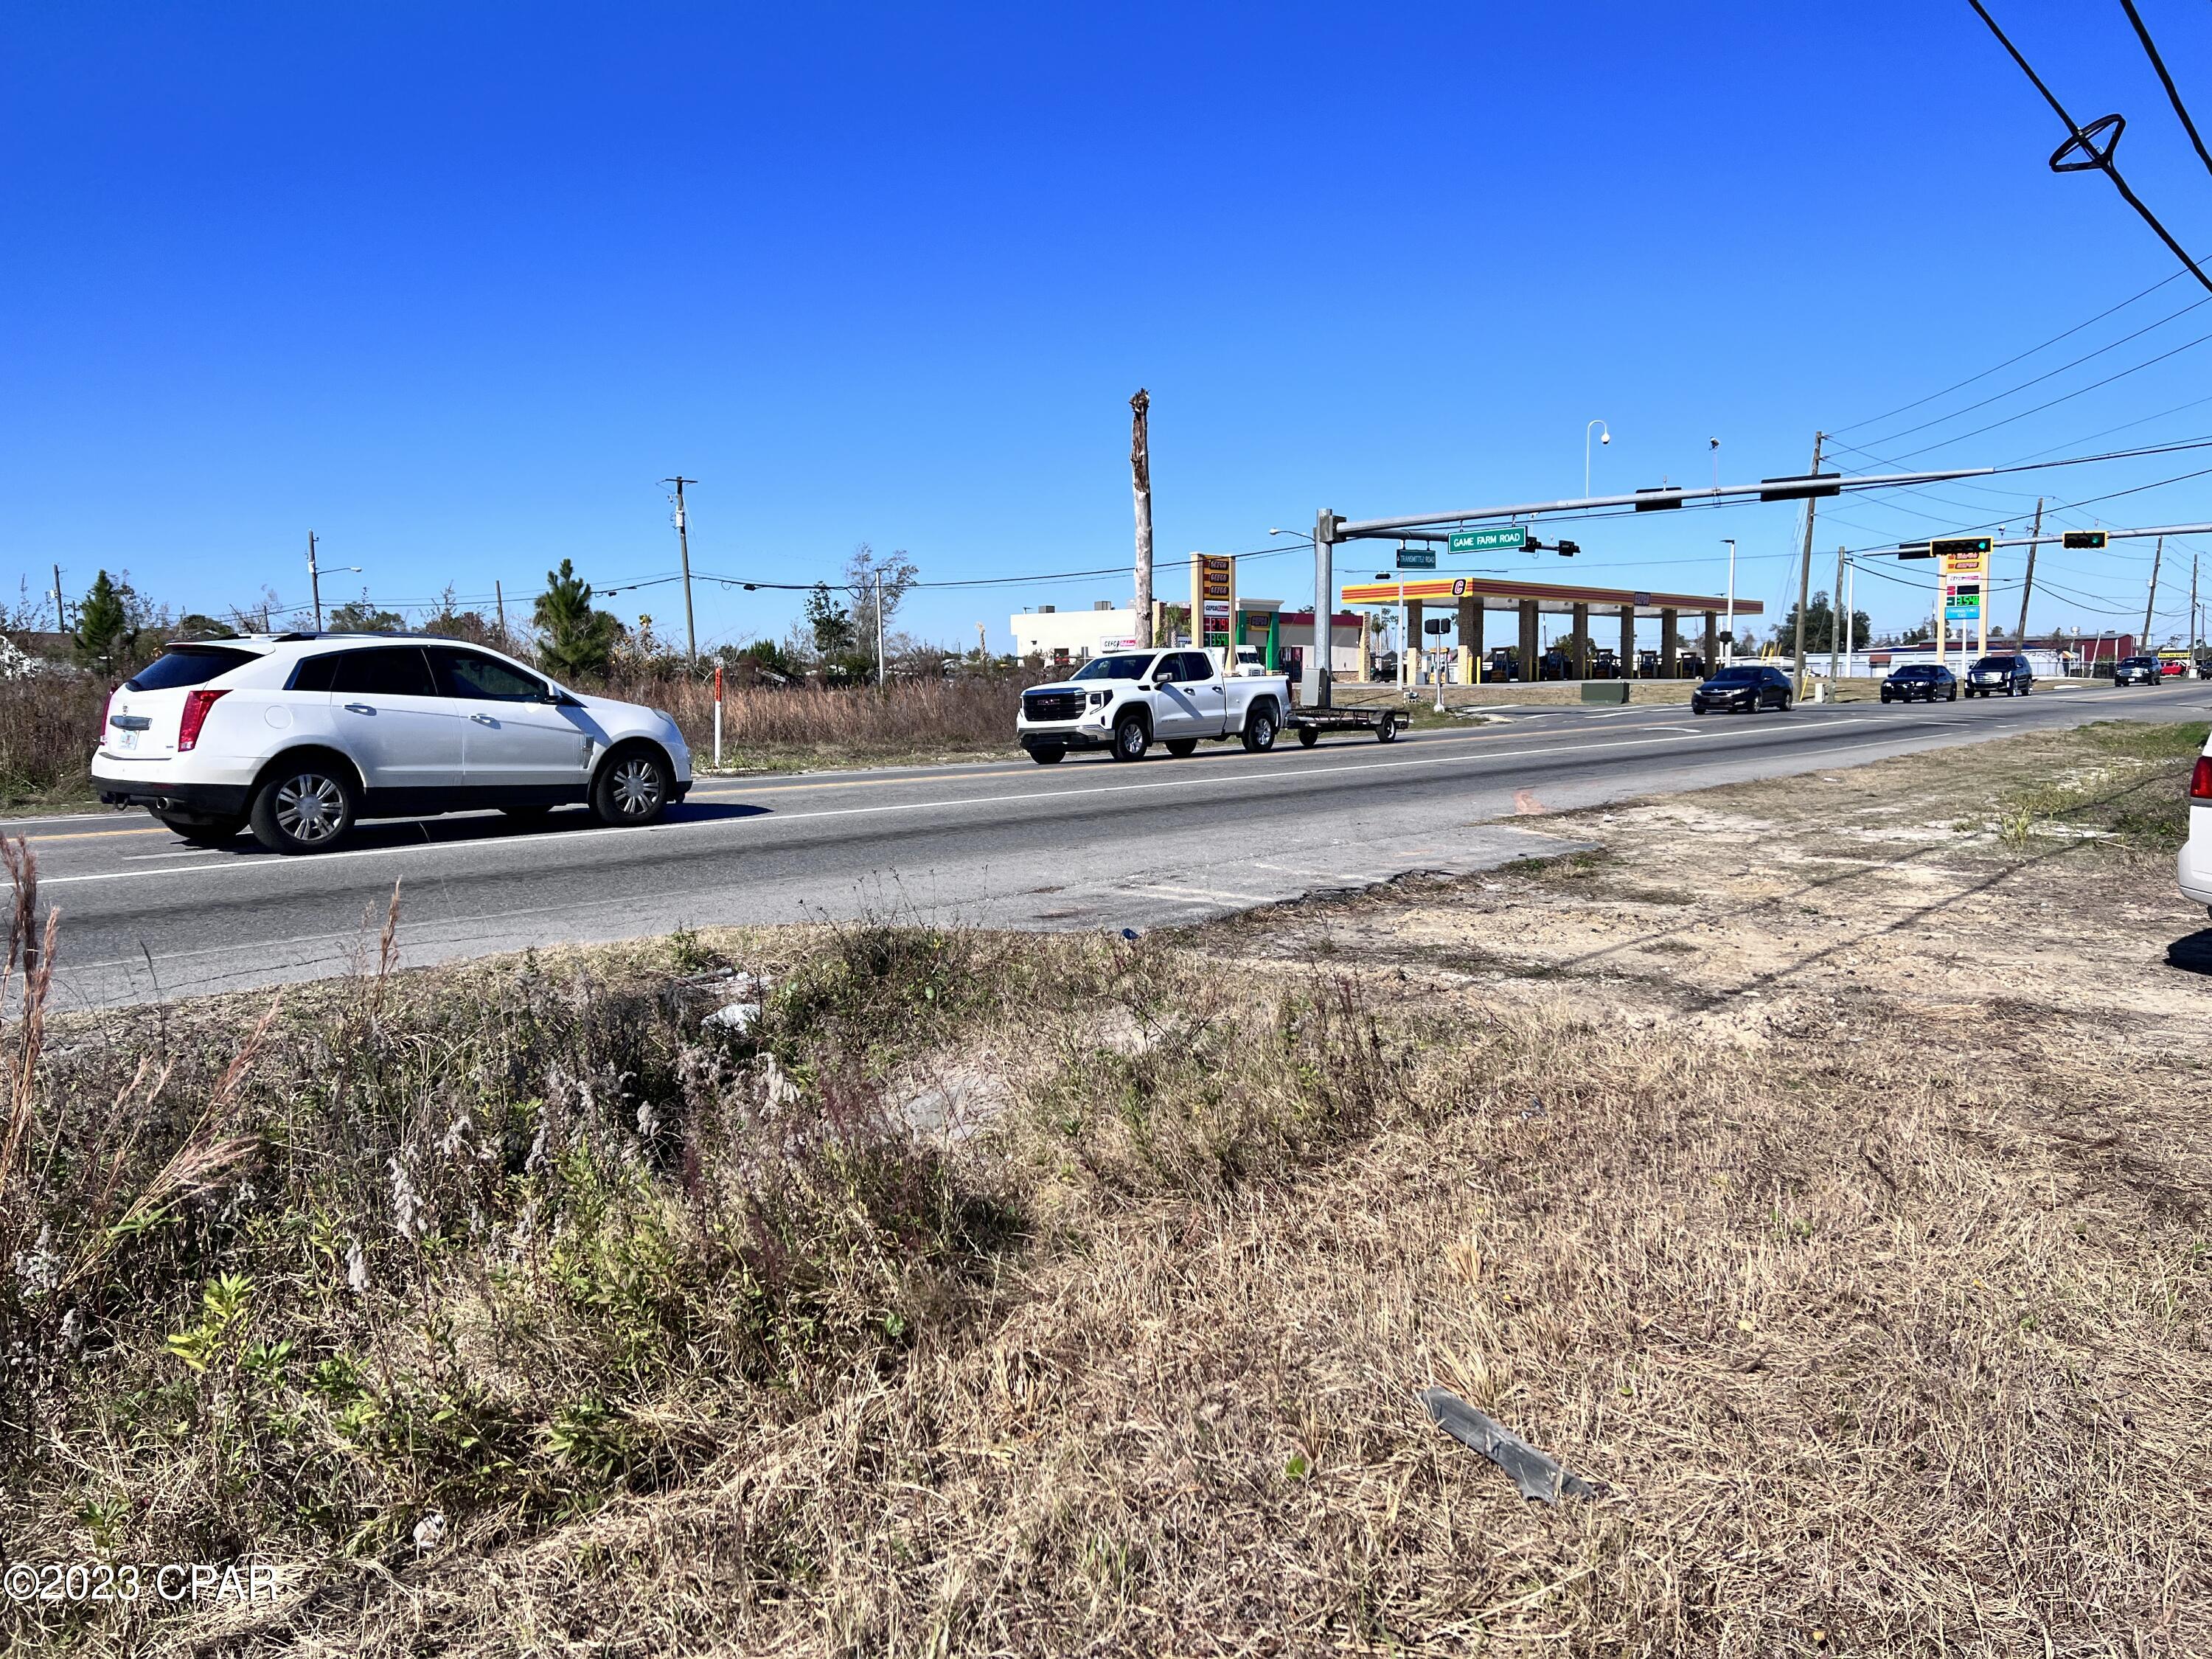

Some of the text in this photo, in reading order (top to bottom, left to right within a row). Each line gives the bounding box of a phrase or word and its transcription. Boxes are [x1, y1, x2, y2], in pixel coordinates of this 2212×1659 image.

[1453, 532, 1520, 548] GAME FARM ROAD
[1400, 554, 1435, 564] TRANSMITTER ROAD
[1454, 580, 1464, 594] C
